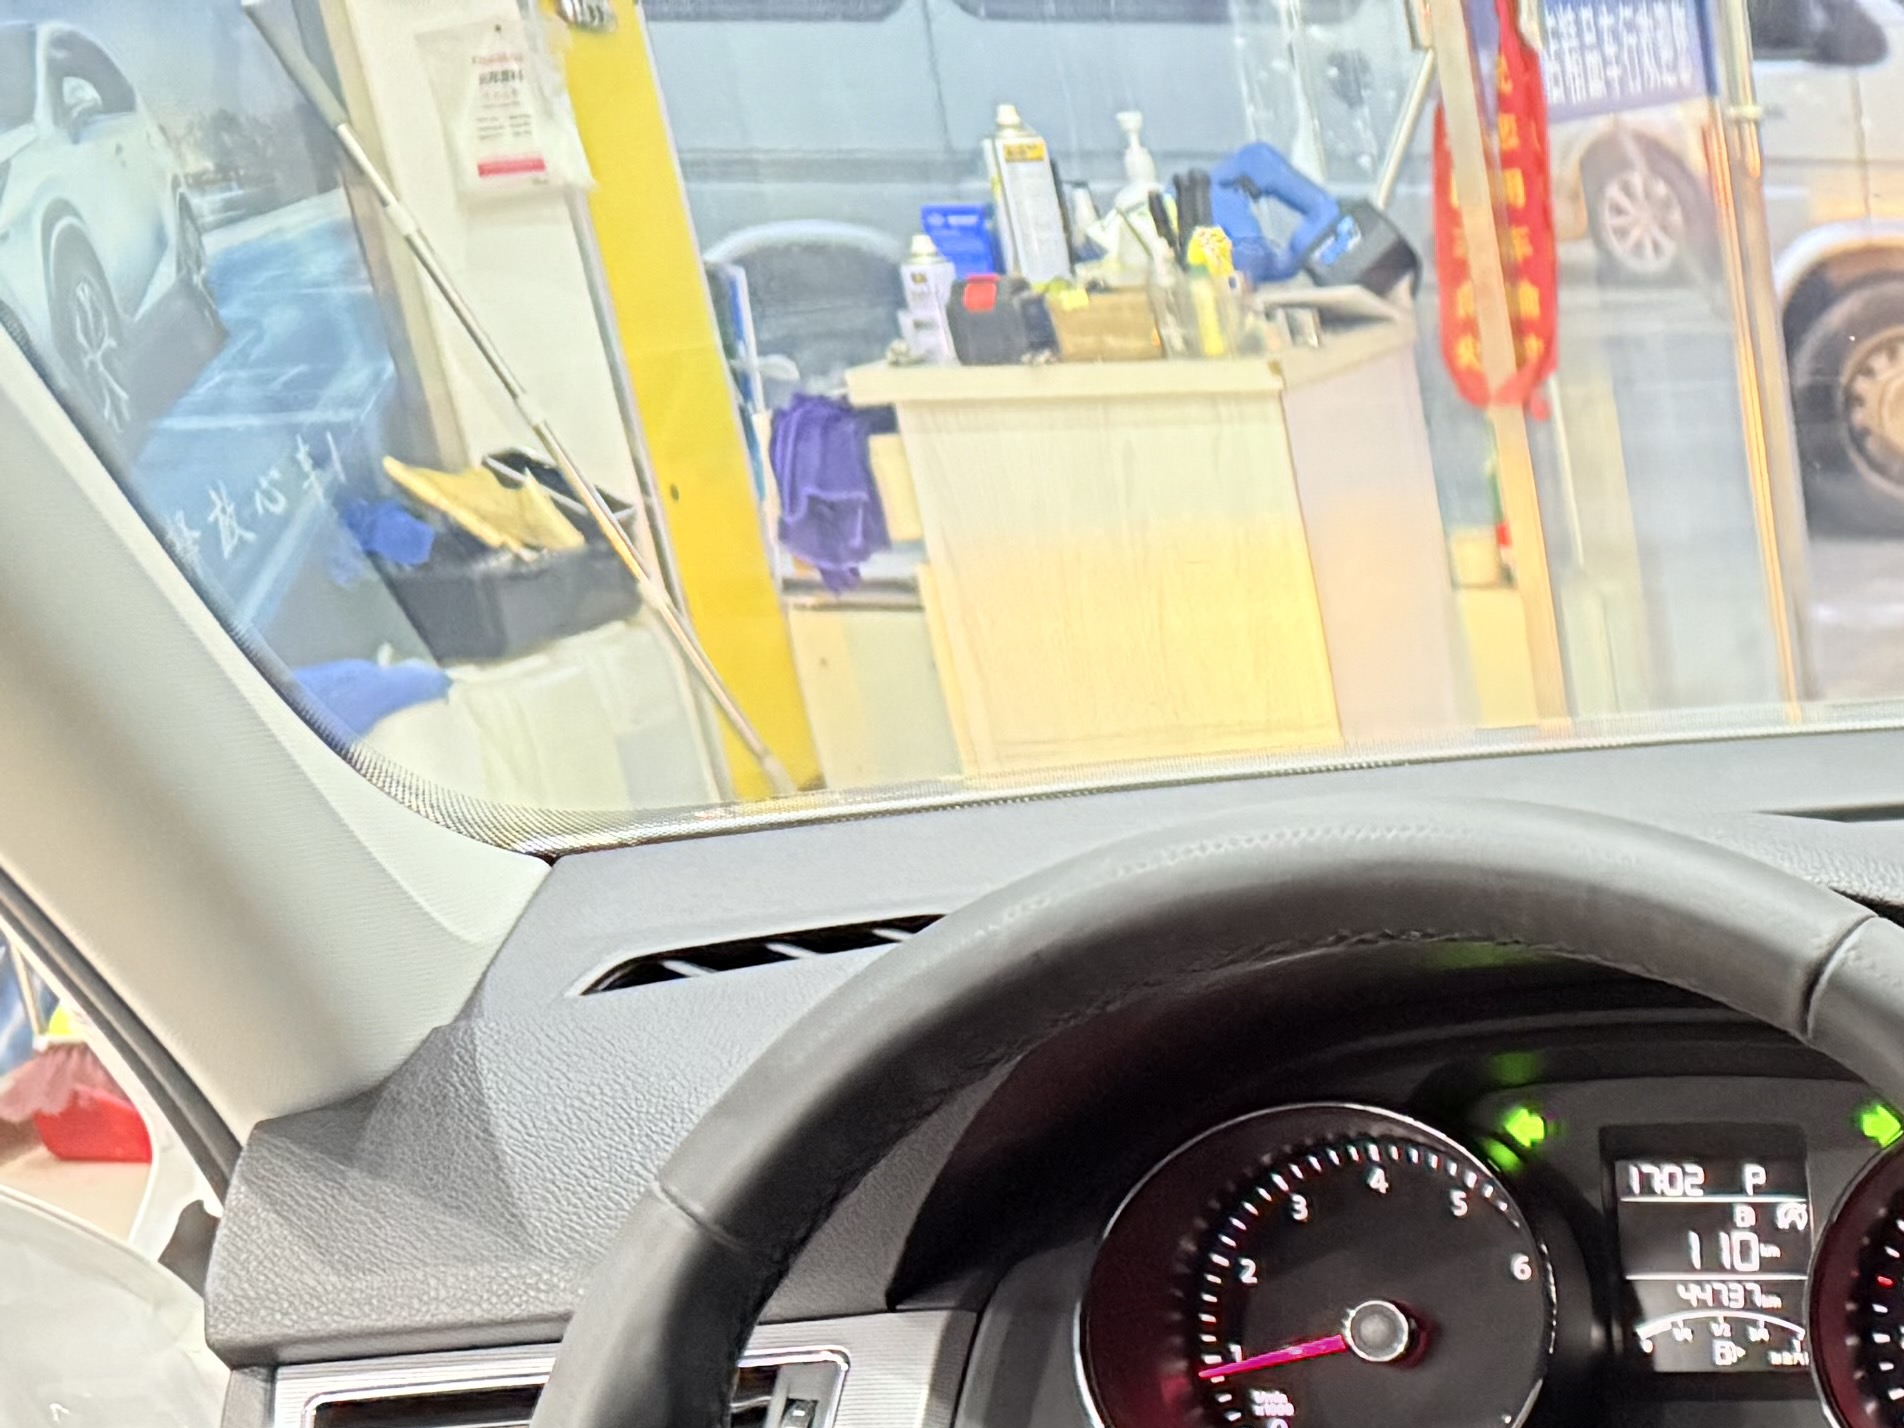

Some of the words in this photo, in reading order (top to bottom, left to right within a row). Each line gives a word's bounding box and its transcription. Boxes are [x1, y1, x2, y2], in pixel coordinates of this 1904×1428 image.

[1365, 1165, 1389, 1194] 4
[1743, 1164, 1767, 1196] P
[1289, 1193, 1309, 1222] 3
[1449, 1189, 1469, 1217] 5
[1688, 1231, 1760, 1272] 110
[1237, 1257, 1258, 1284] 2
[1511, 1254, 1533, 1281] 6
[1676, 1281, 1762, 1309] 44737
